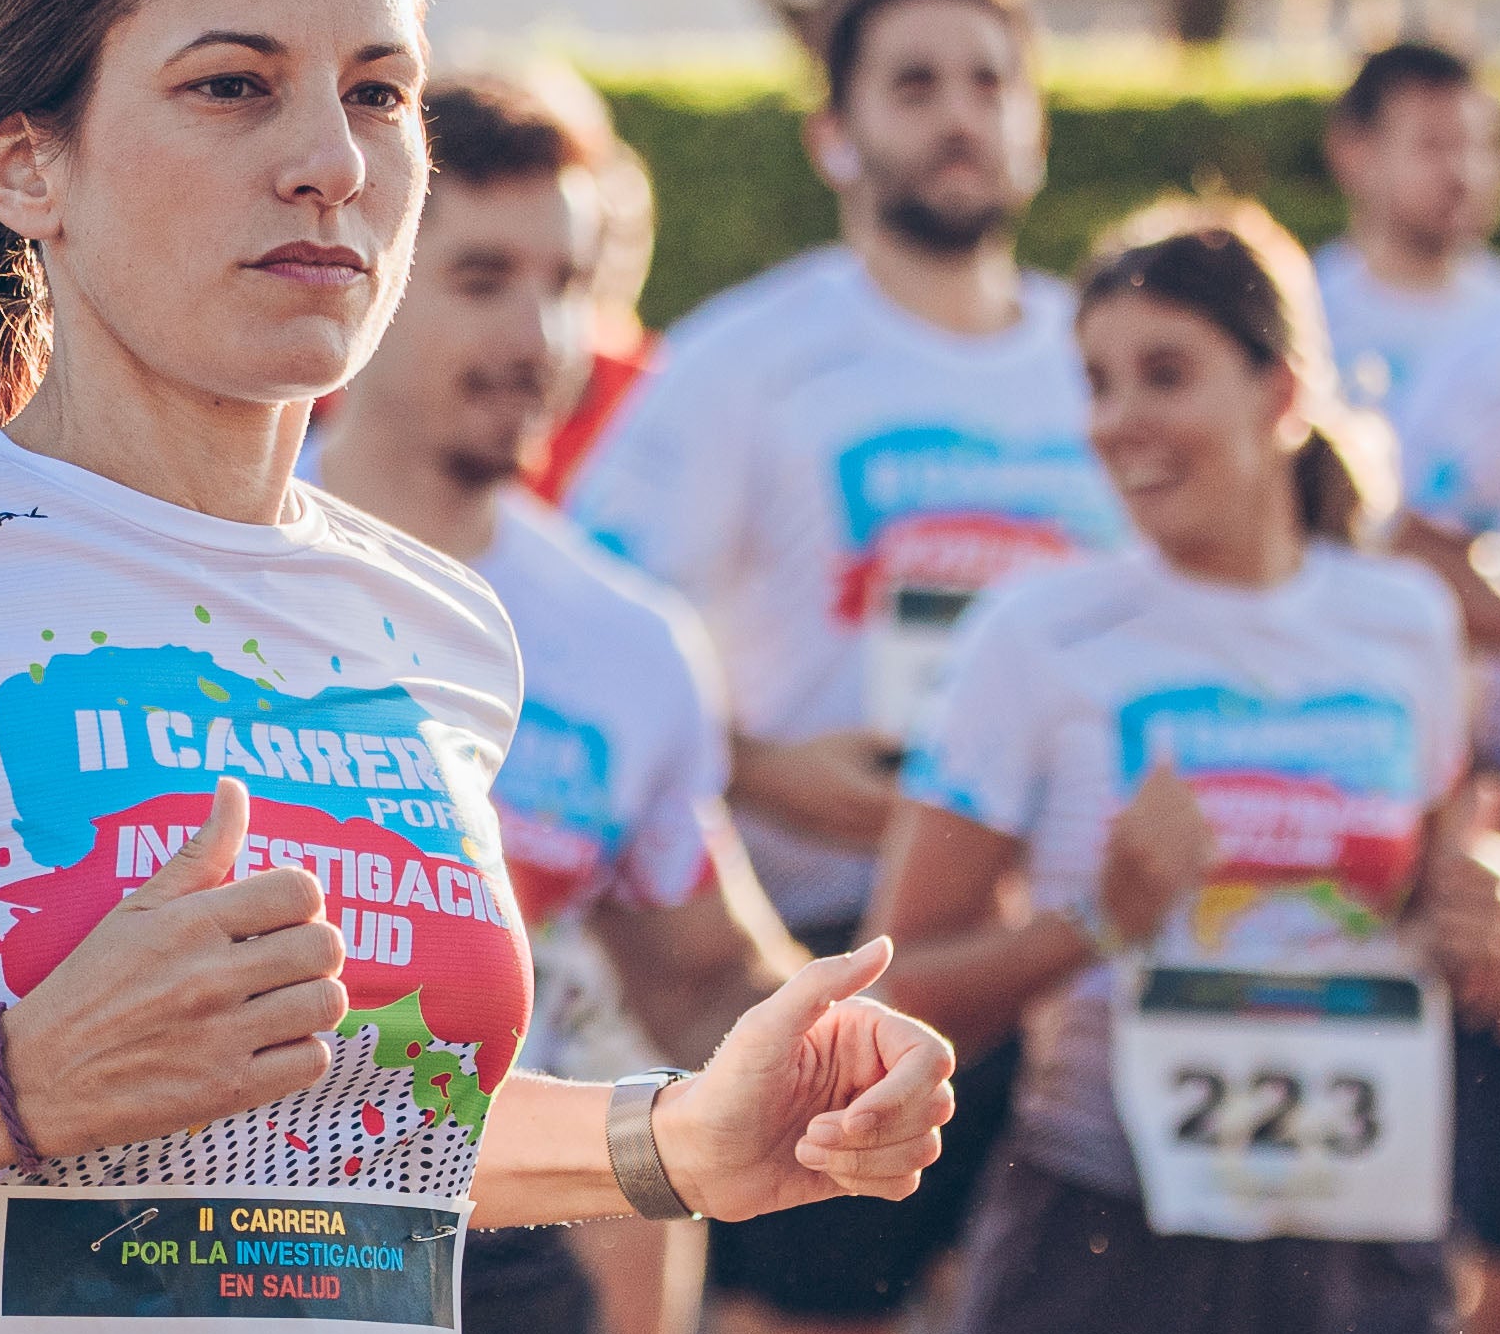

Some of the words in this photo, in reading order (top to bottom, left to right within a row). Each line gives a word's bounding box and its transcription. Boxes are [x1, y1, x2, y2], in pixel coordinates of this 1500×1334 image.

[74, 709, 129, 772] II
[145, 710, 445, 793] CARRER
[1172, 1066, 1382, 1159] 223
[199, 1207, 214, 1231] II
[230, 1207, 346, 1235] CARRERA
[121, 1241, 179, 1265] POR
[190, 1240, 228, 1265] LA
[236, 1240, 404, 1271] INVESTIGACIÓN
[219, 1273, 254, 1297] EN
[262, 1274, 341, 1299] SALUD
